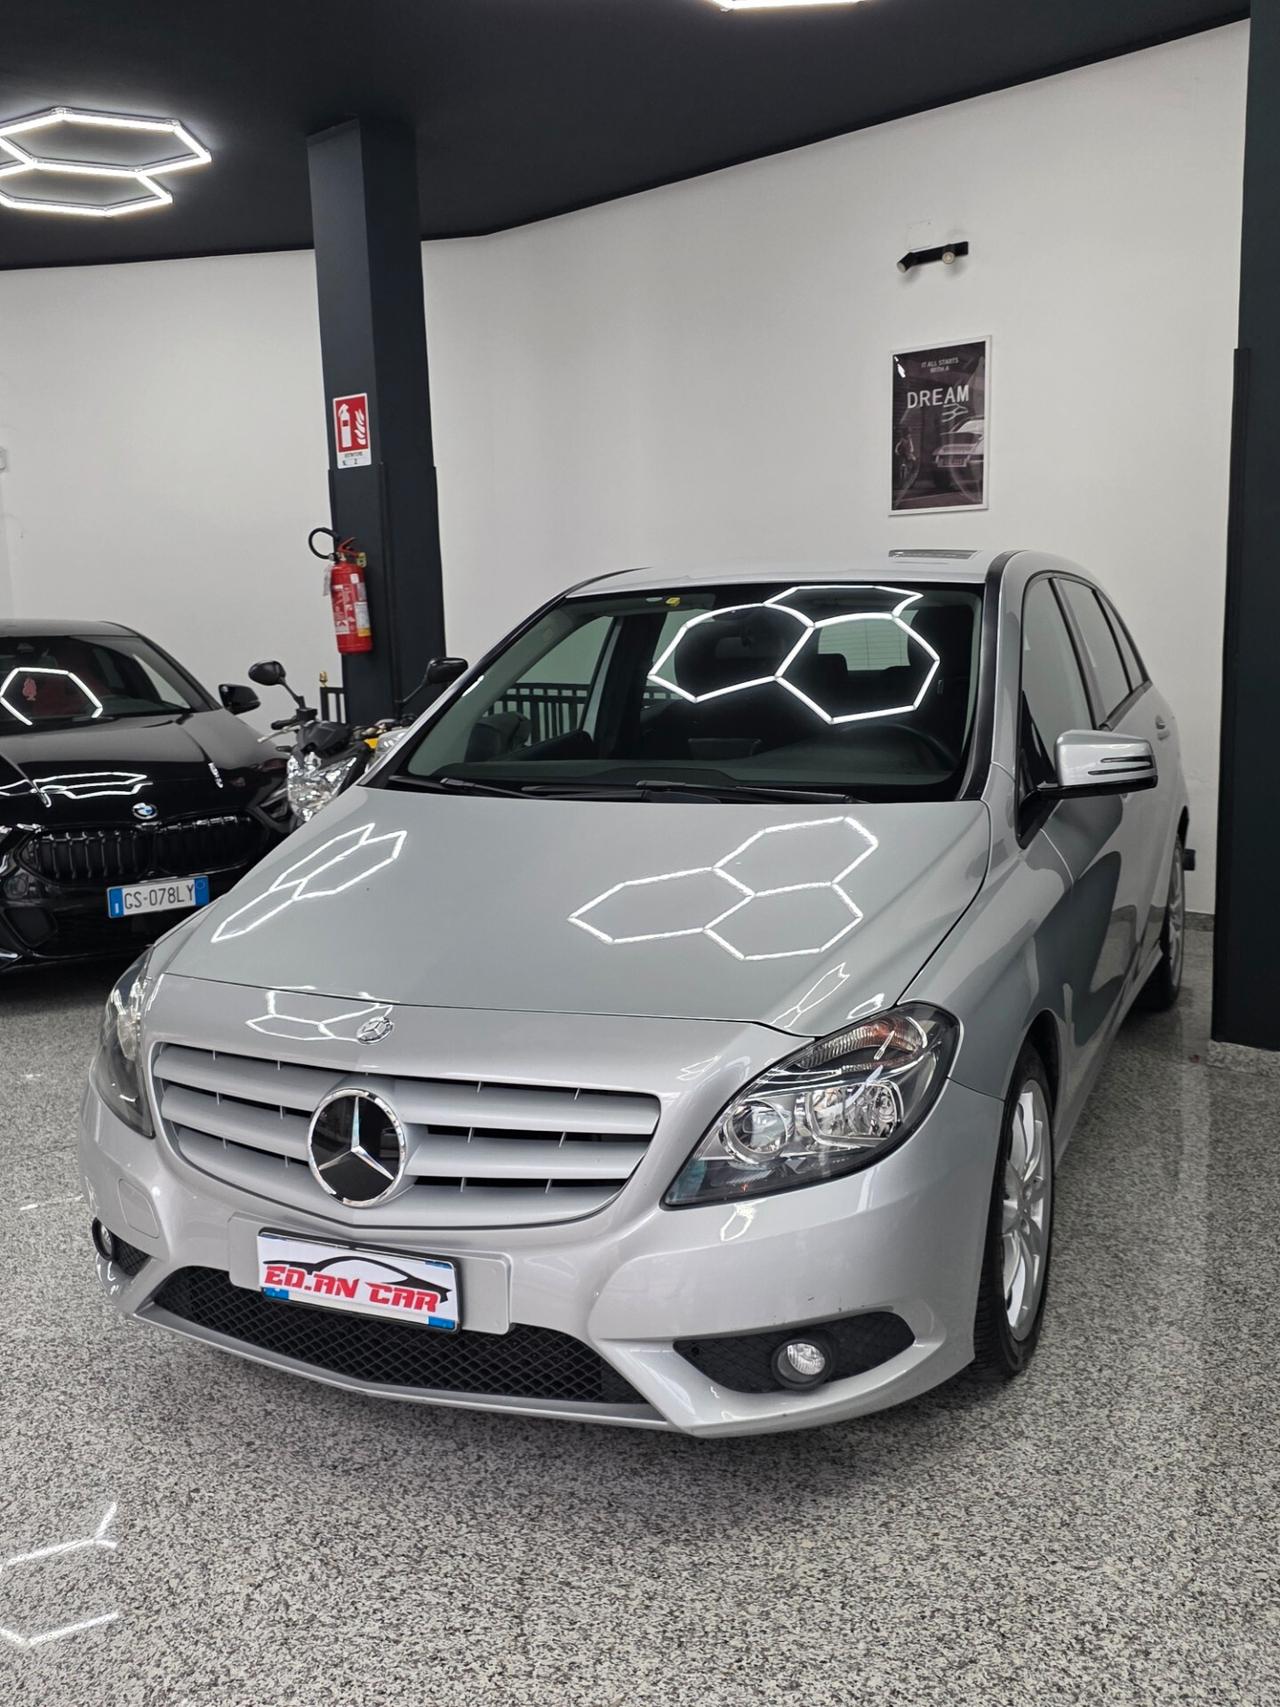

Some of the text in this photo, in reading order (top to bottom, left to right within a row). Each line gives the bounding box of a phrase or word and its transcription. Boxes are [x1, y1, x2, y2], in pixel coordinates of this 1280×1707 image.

[927, 360, 938, 368] ALL
[938, 357, 959, 366] STARTS
[907, 384, 969, 409] DREAM
[264, 1265, 441, 1313] ED.AN CAR
